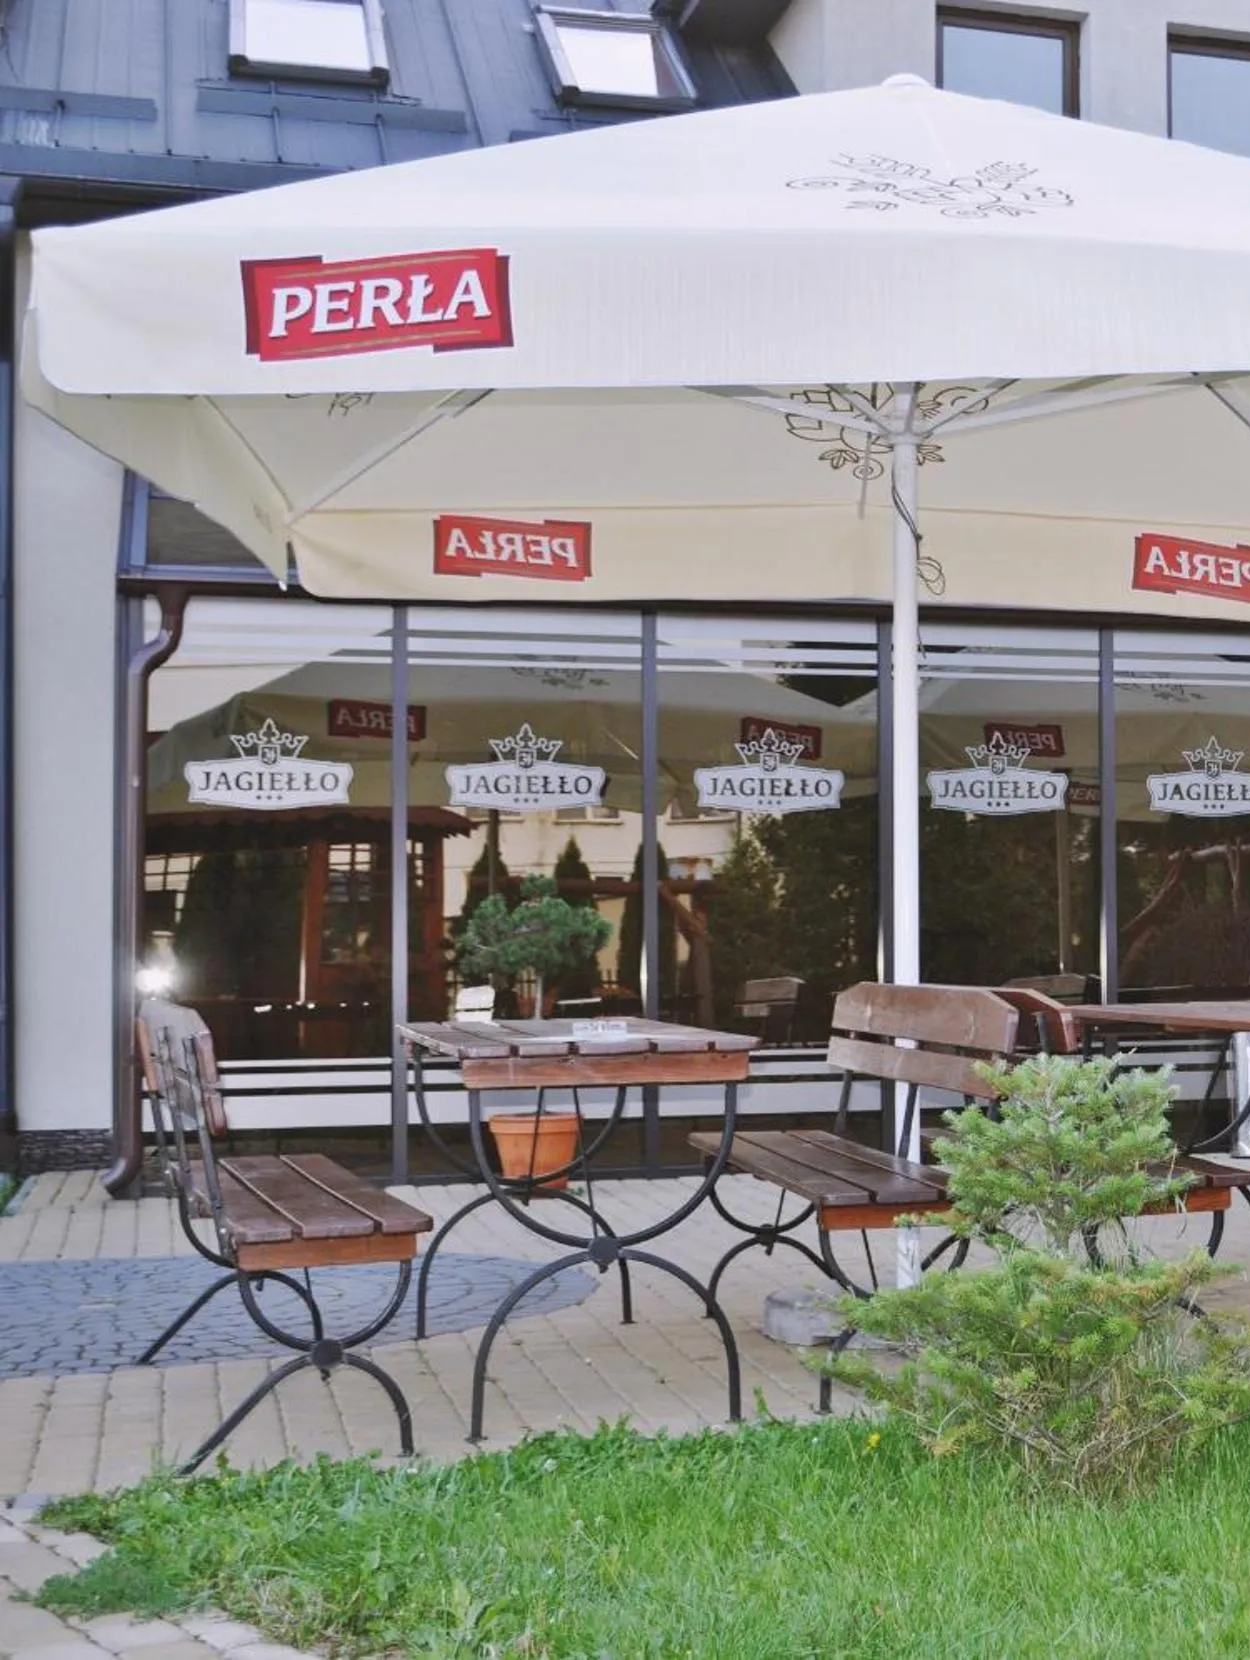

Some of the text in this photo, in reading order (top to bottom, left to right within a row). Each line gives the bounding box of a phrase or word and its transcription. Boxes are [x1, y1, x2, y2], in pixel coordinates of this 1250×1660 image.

[267, 269, 493, 339] PERŁA
[198, 771, 340, 792] JAGIEŁŁO
[459, 774, 593, 795] JAGIEŁŁO
[706, 777, 833, 798] JAGIEŁŁO
[938, 780, 1058, 800] JAGIEŁŁO
